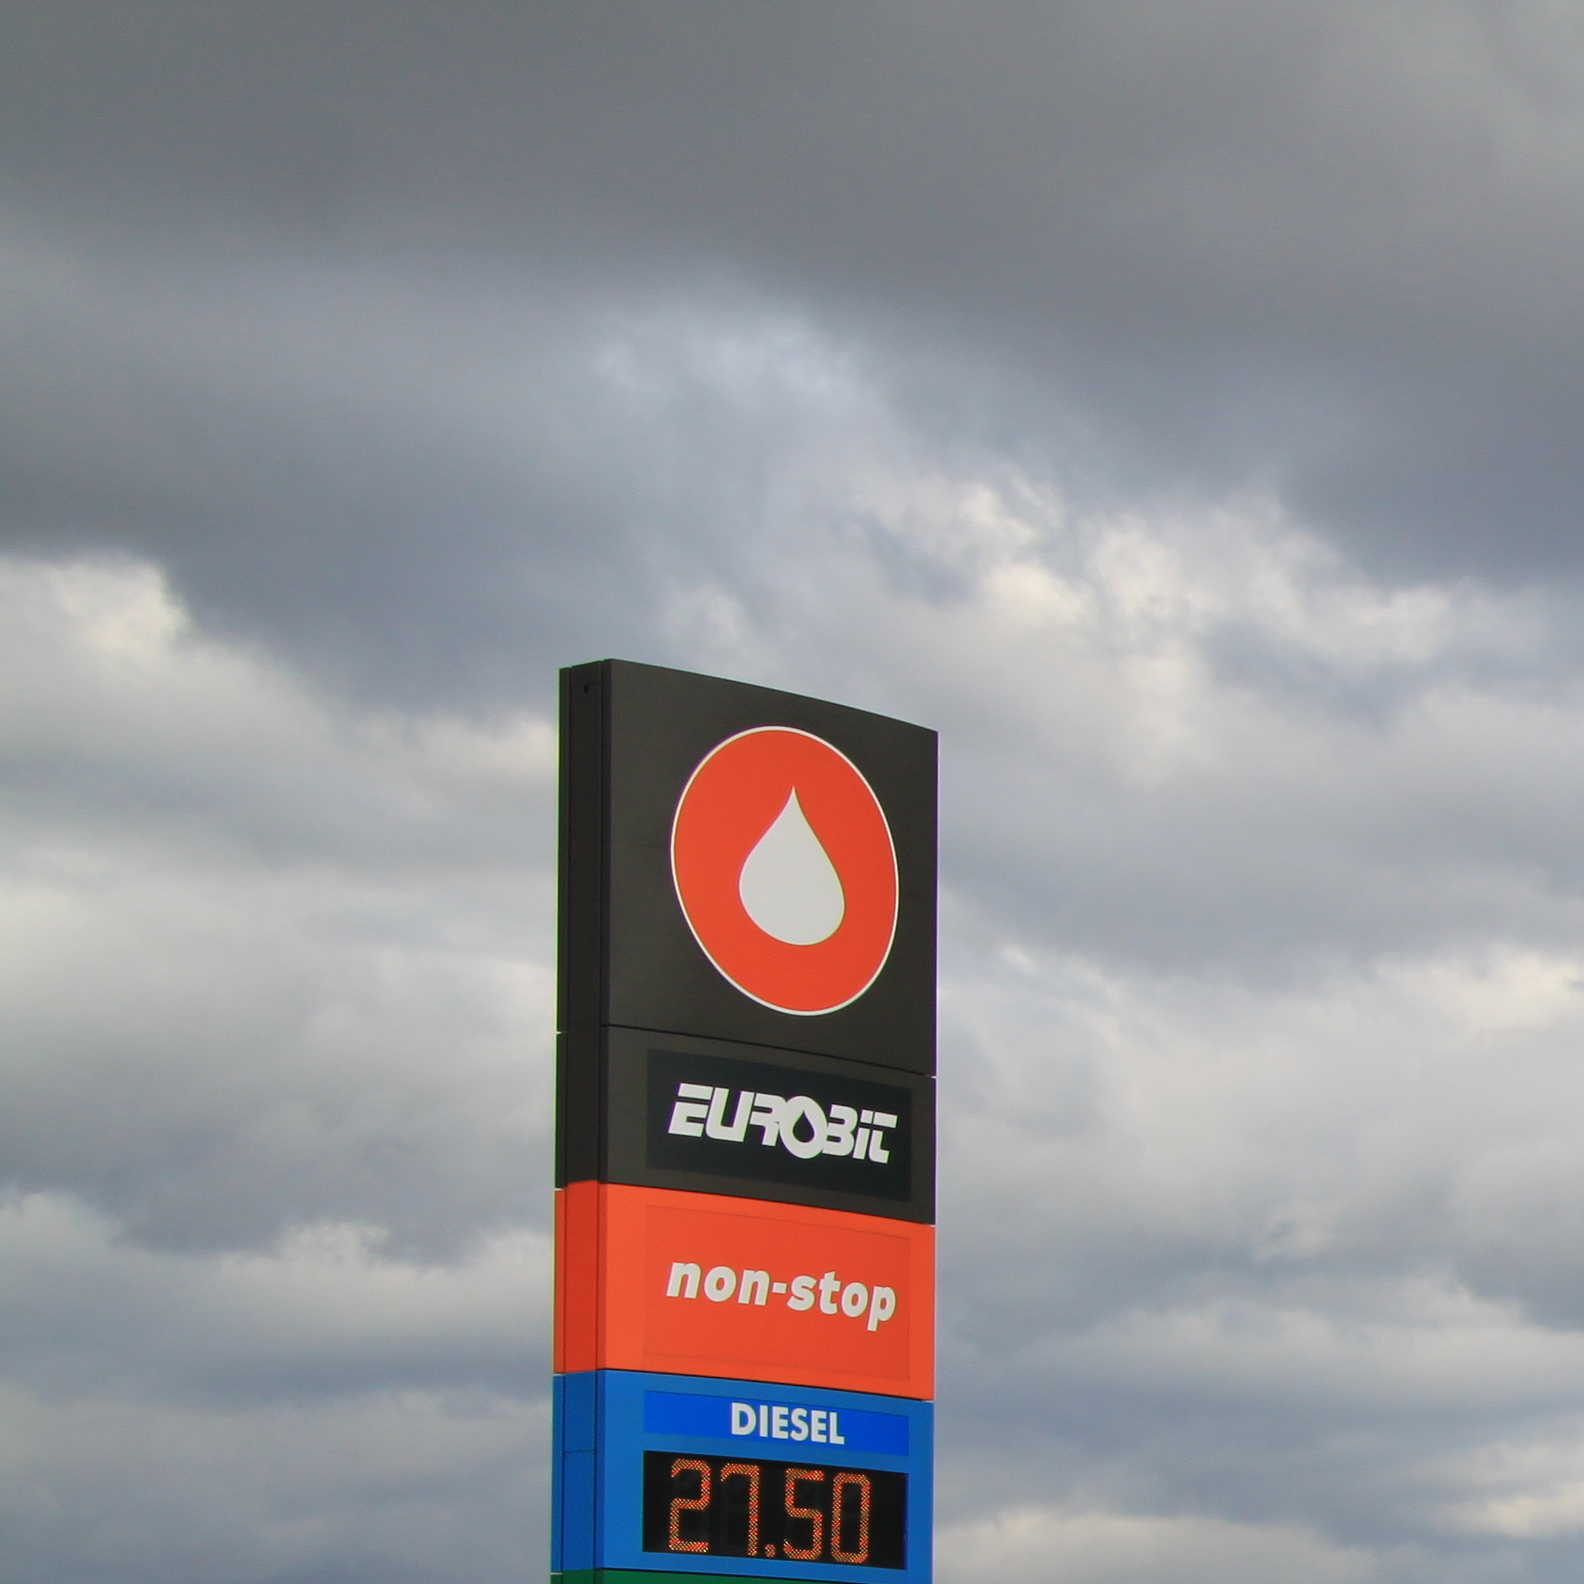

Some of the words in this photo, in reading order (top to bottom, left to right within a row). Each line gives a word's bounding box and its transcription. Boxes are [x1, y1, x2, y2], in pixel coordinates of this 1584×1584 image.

[666, 1260, 897, 1332] non-stop
[730, 1401, 845, 1445] DIESEL
[668, 1458, 871, 1564] 27.50
